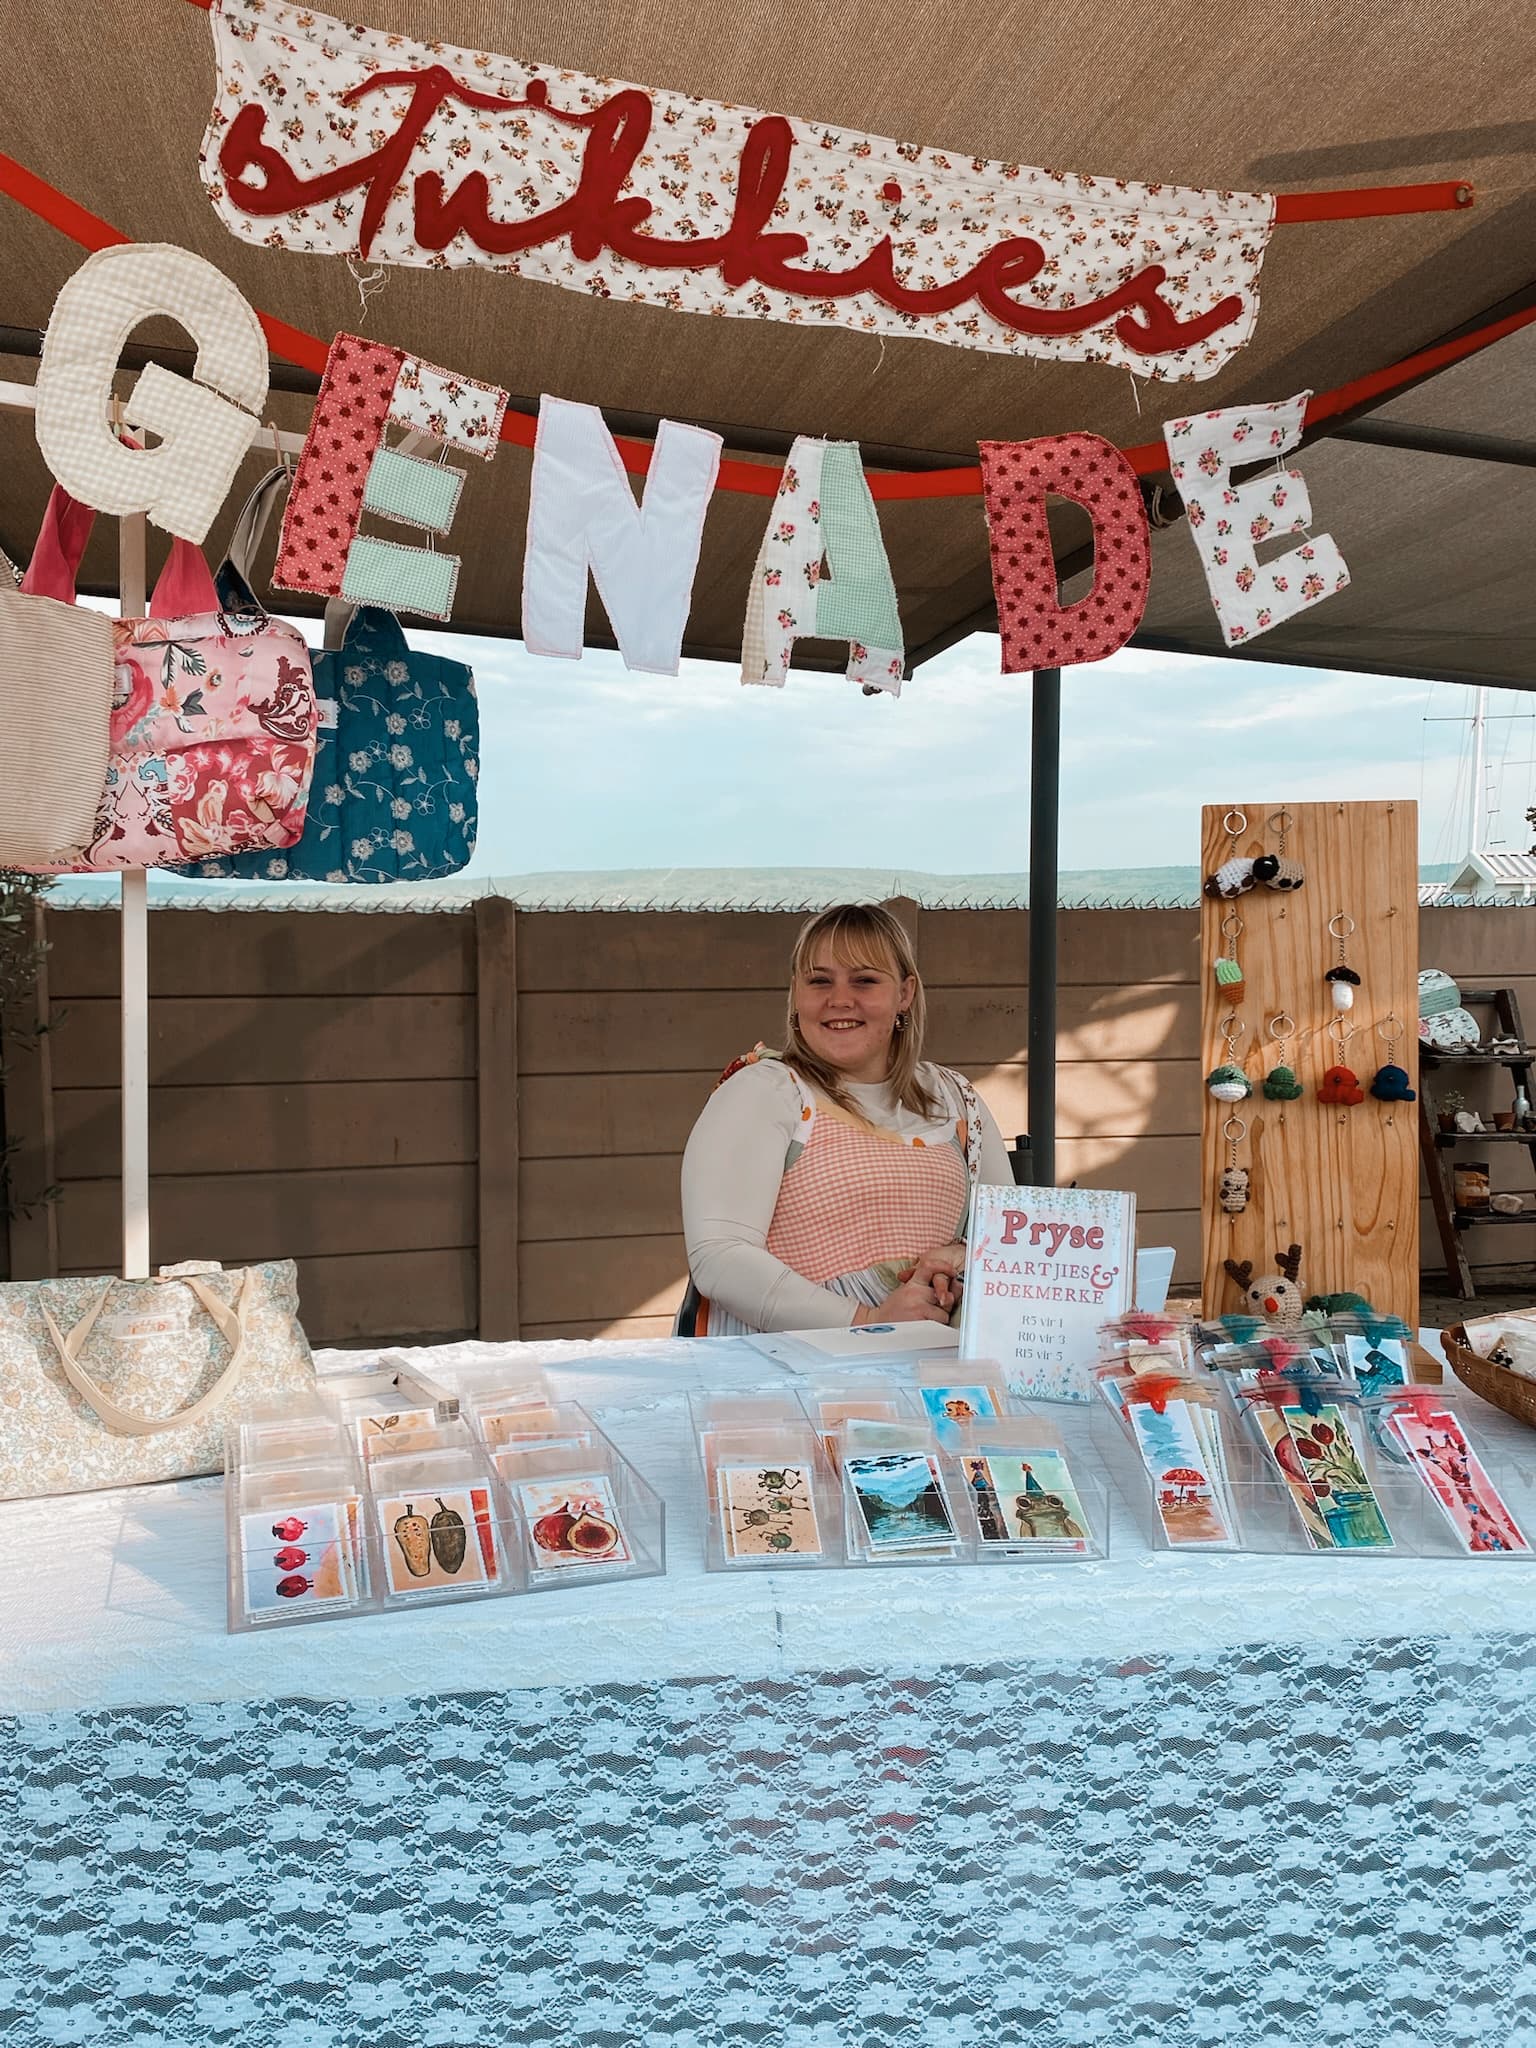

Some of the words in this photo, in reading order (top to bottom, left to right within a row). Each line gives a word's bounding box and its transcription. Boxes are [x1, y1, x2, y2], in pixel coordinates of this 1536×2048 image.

[35, 242, 1351, 697] GENADE
[1000, 1210, 1104, 1257] Pryse
[1022, 1315, 1037, 1326] R5
[1040, 1317, 1056, 1327] vir
[1018, 1331, 1036, 1342] R10
[1039, 1333, 1056, 1344] vir
[1058, 1335, 1066, 1345] 3
[1015, 1347, 1033, 1359] R15
[1036, 1350, 1054, 1361] vir
[1056, 1351, 1063, 1361] 5
